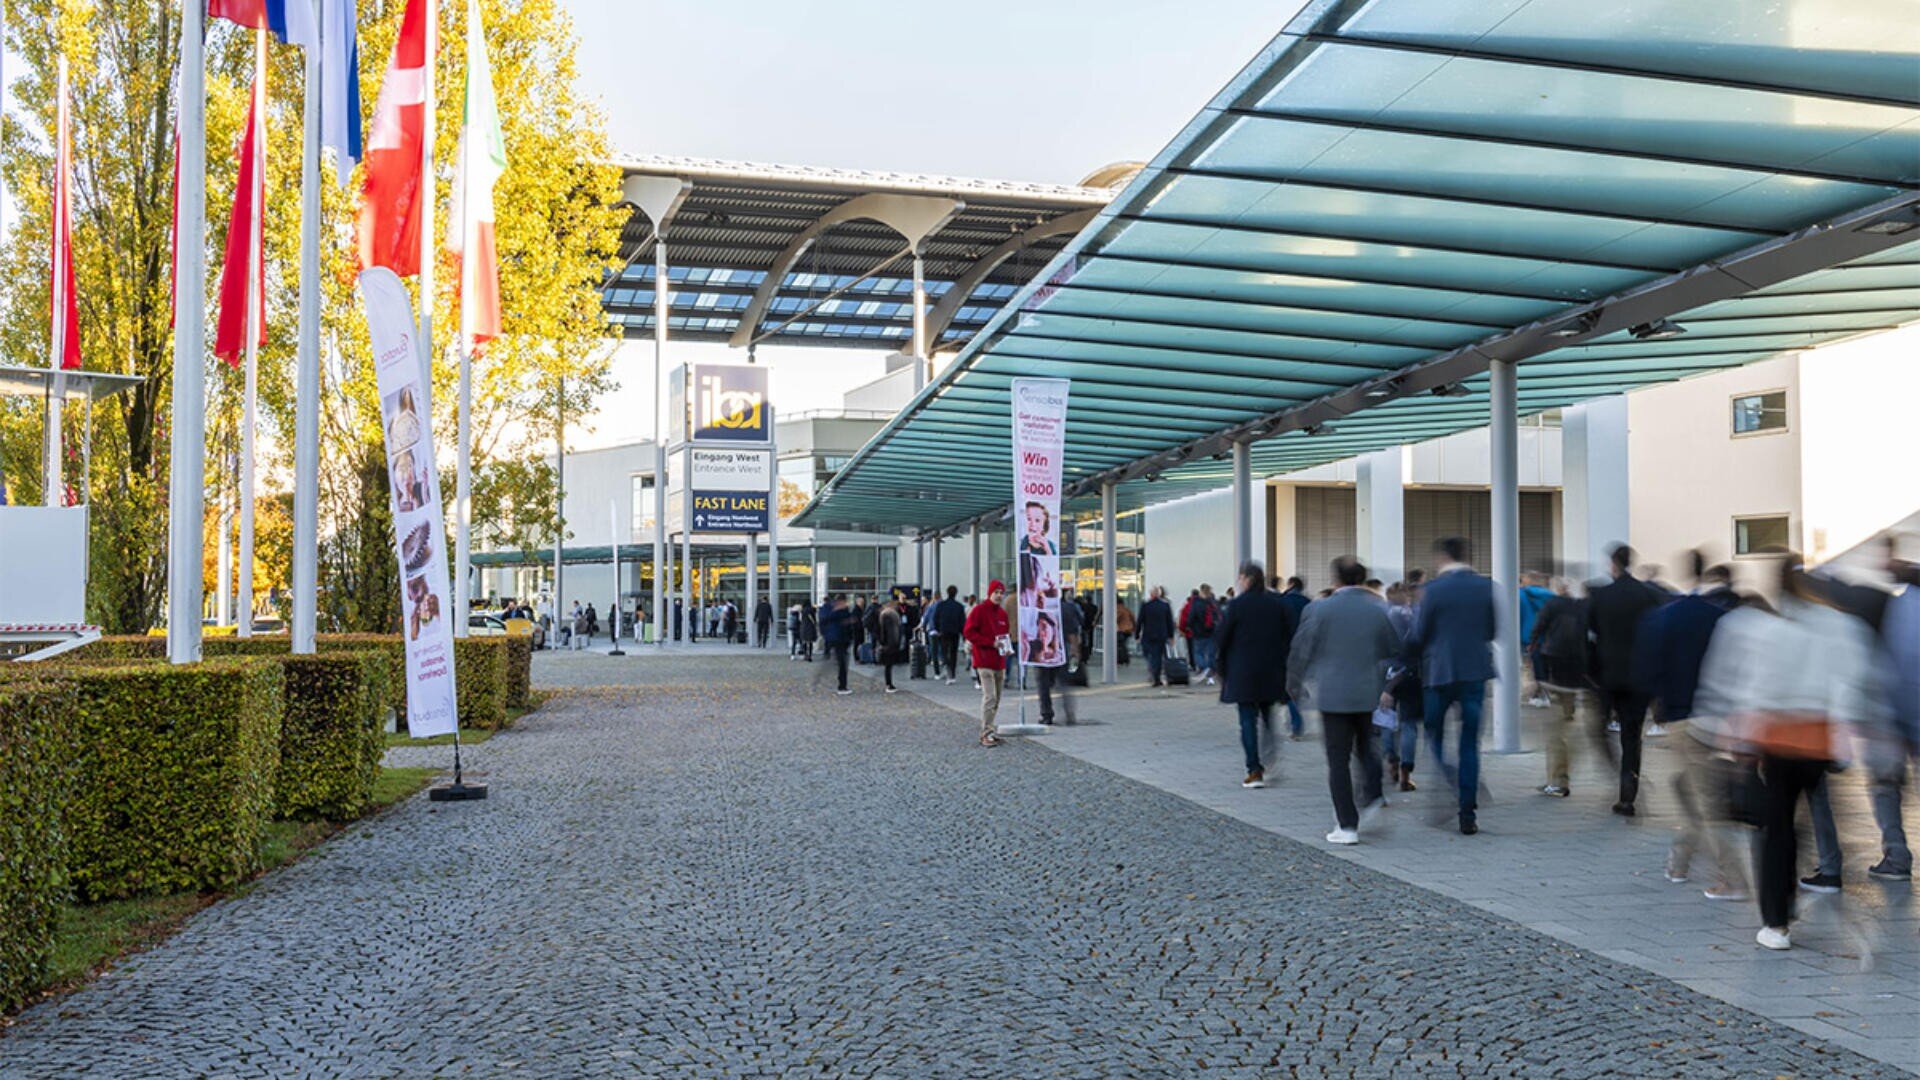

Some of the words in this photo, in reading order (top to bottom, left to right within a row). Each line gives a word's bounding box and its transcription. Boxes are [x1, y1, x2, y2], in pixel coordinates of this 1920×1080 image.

[702, 375, 761, 429] iba
[694, 452, 734, 463] Eingang
[735, 454, 760, 463] West
[1023, 451, 1049, 467] Win
[694, 464, 736, 473] Entrance
[737, 465, 762, 474] West
[695, 497, 728, 510] FAST
[731, 498, 767, 511] LANE
